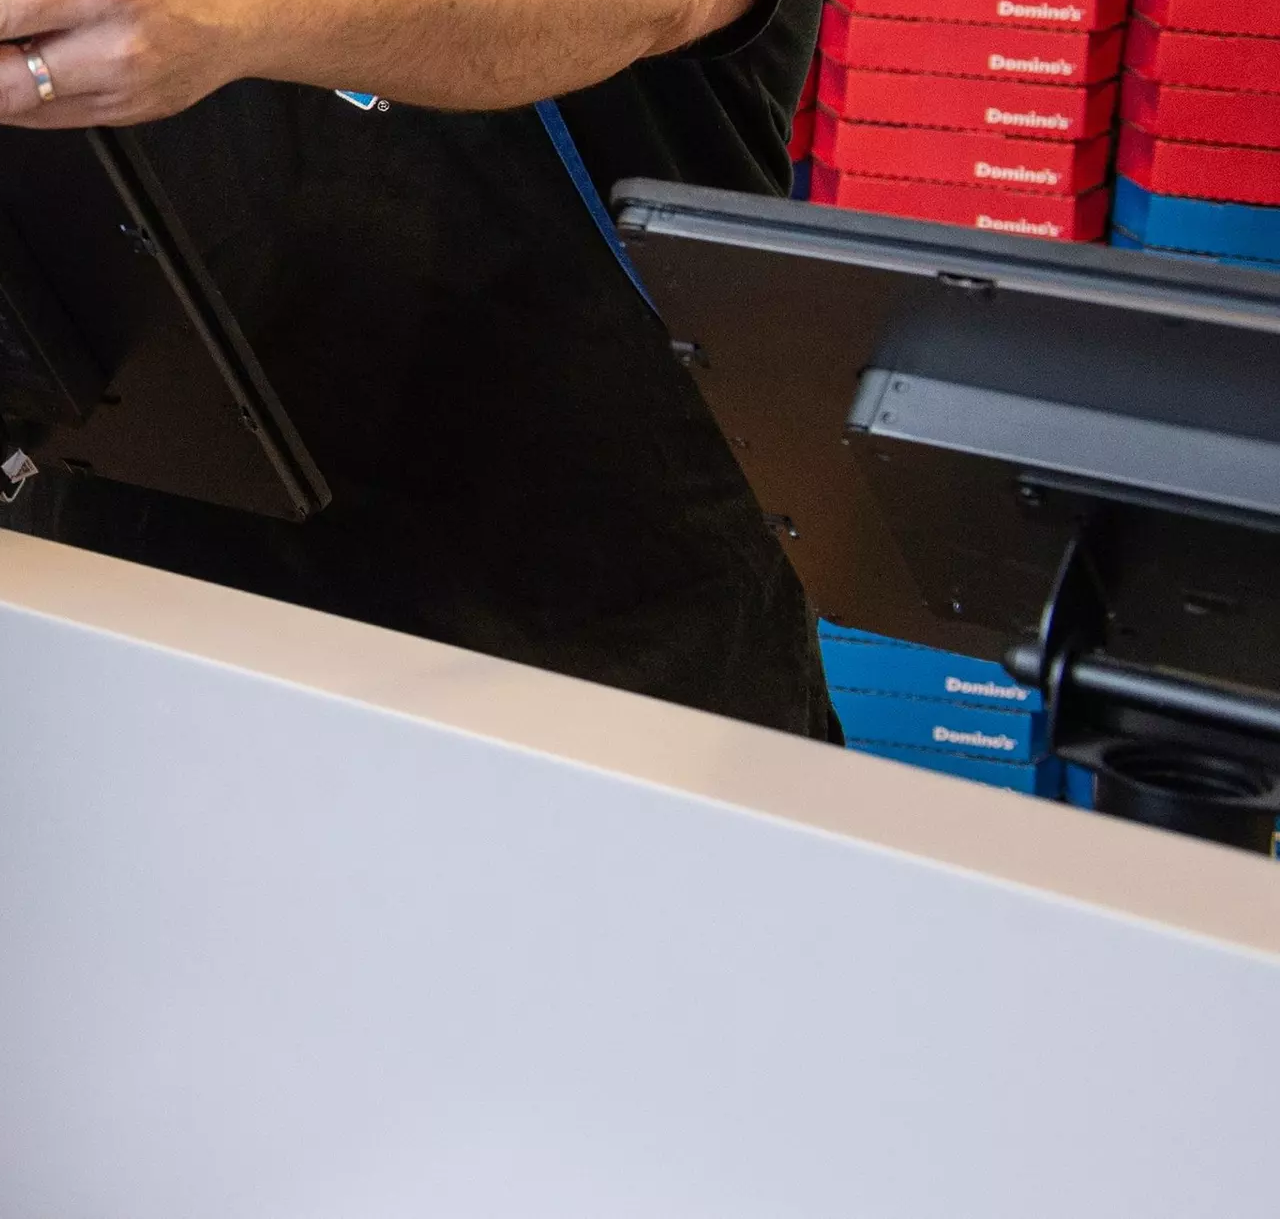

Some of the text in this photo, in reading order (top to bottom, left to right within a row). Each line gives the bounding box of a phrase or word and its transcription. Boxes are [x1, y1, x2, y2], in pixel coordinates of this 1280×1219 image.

[997, 0, 1085, 21] Domino's
[988, 54, 1077, 75] Domino's
[984, 107, 1073, 130] Domino's
[974, 161, 1061, 185] Domino's
[945, 677, 1030, 700] Domino's
[932, 726, 1017, 750] Domino's
